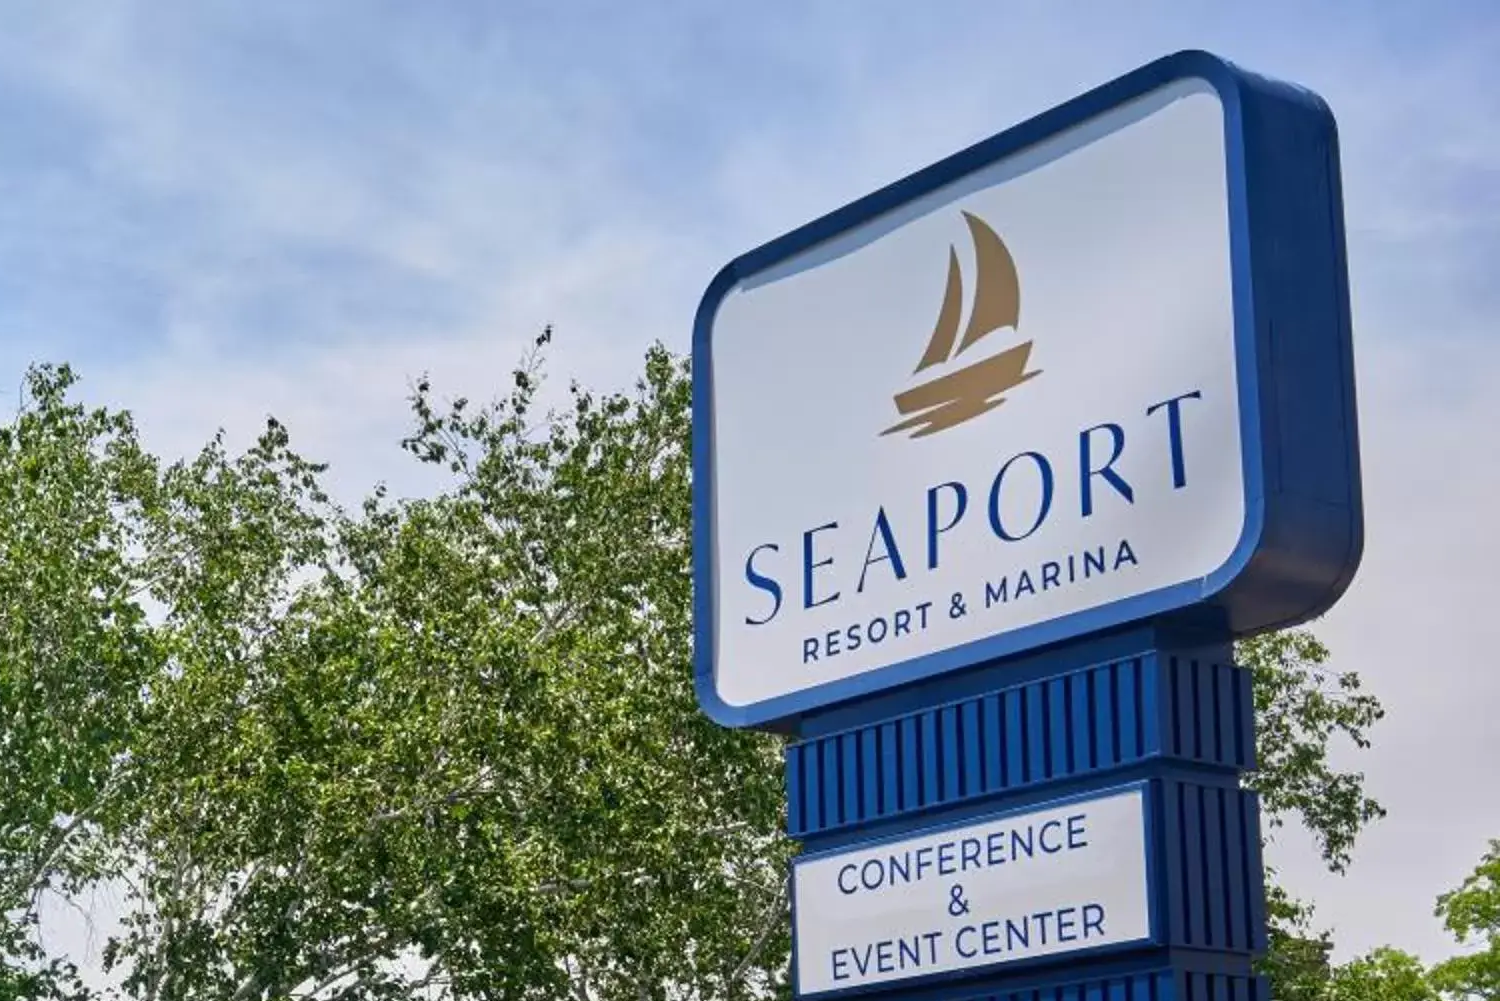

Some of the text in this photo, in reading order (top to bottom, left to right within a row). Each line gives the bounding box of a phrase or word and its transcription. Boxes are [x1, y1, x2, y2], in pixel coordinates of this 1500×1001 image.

[745, 391, 1202, 626] SEAPORT
[803, 539, 1139, 663] RESORT & MARINA
[837, 815, 1089, 895] CONFERENCE
[948, 884, 970, 917] &
[831, 903, 1106, 980] EVENT CENTER
